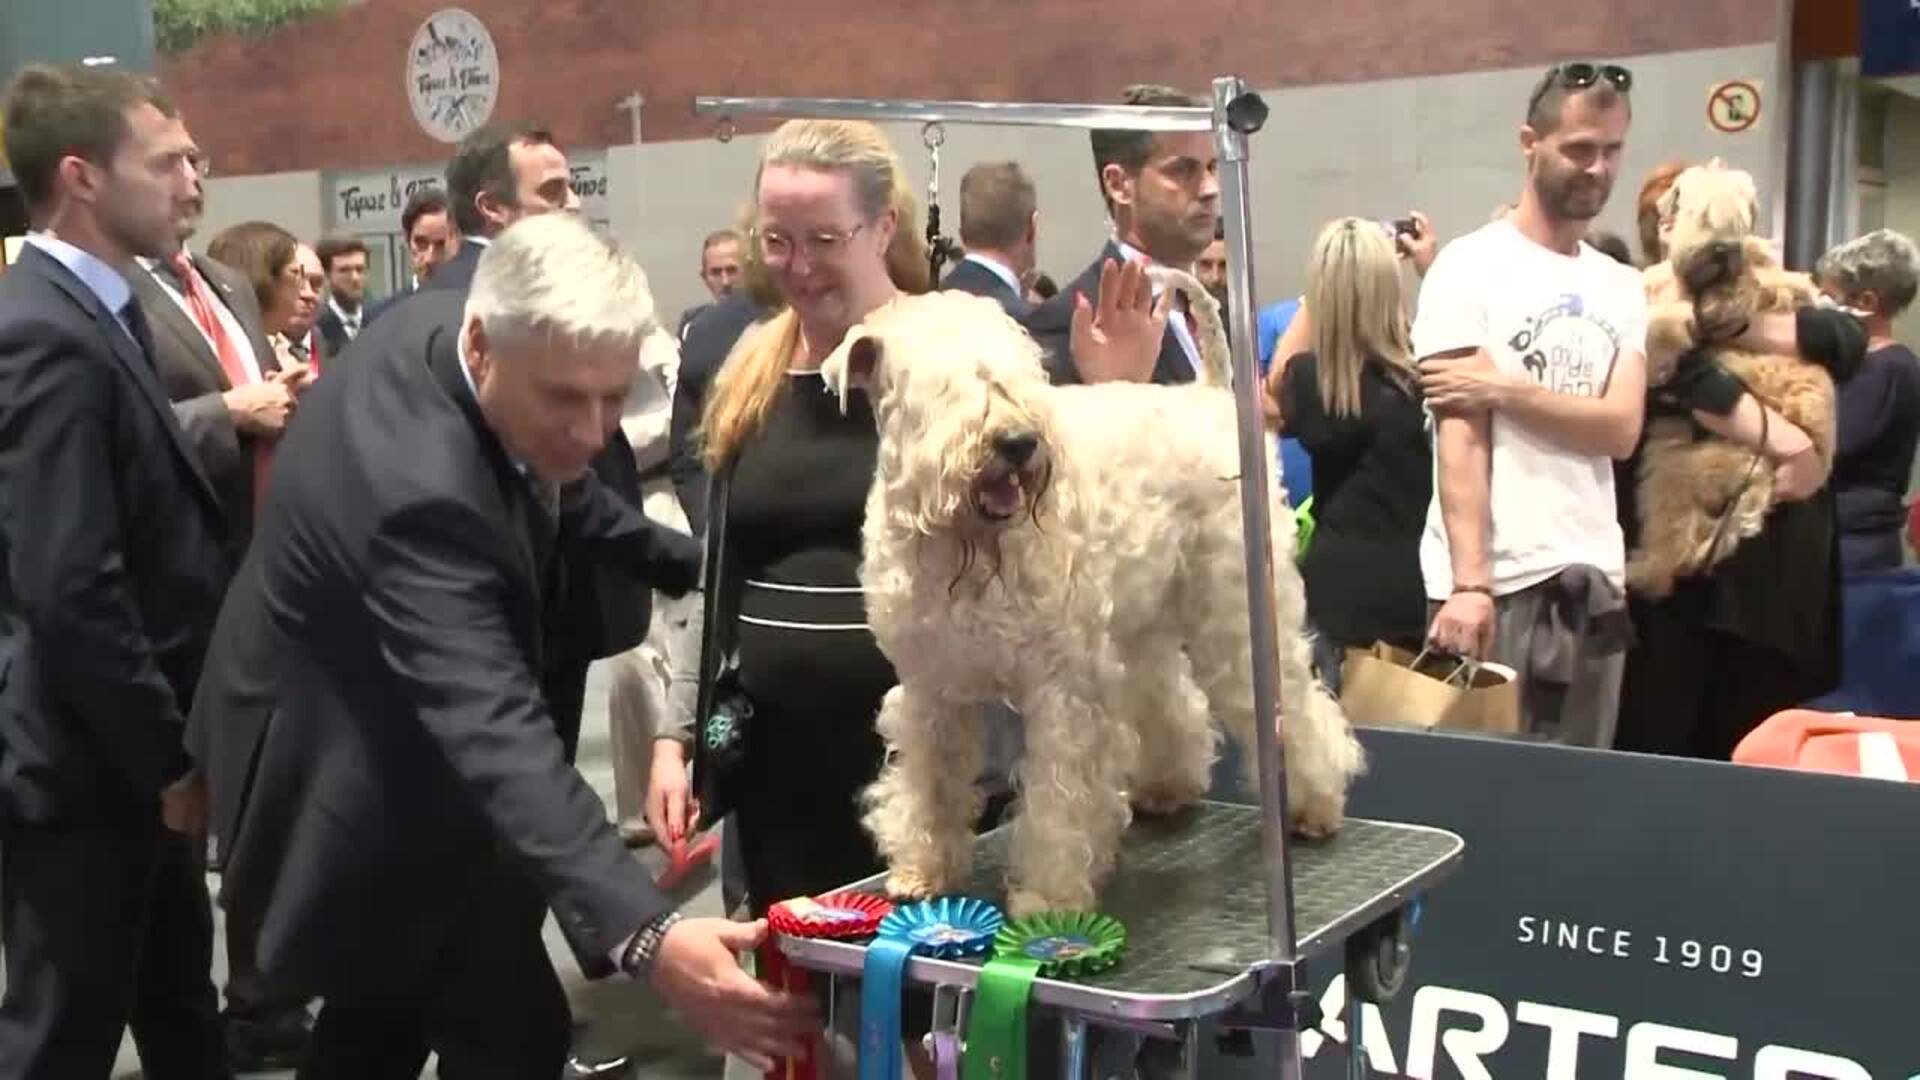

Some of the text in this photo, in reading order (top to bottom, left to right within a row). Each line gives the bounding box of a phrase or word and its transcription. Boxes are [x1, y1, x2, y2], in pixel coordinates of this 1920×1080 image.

[1516, 915, 1763, 978] SINCE 1909
[1300, 972, 1920, 1080] ARTE
